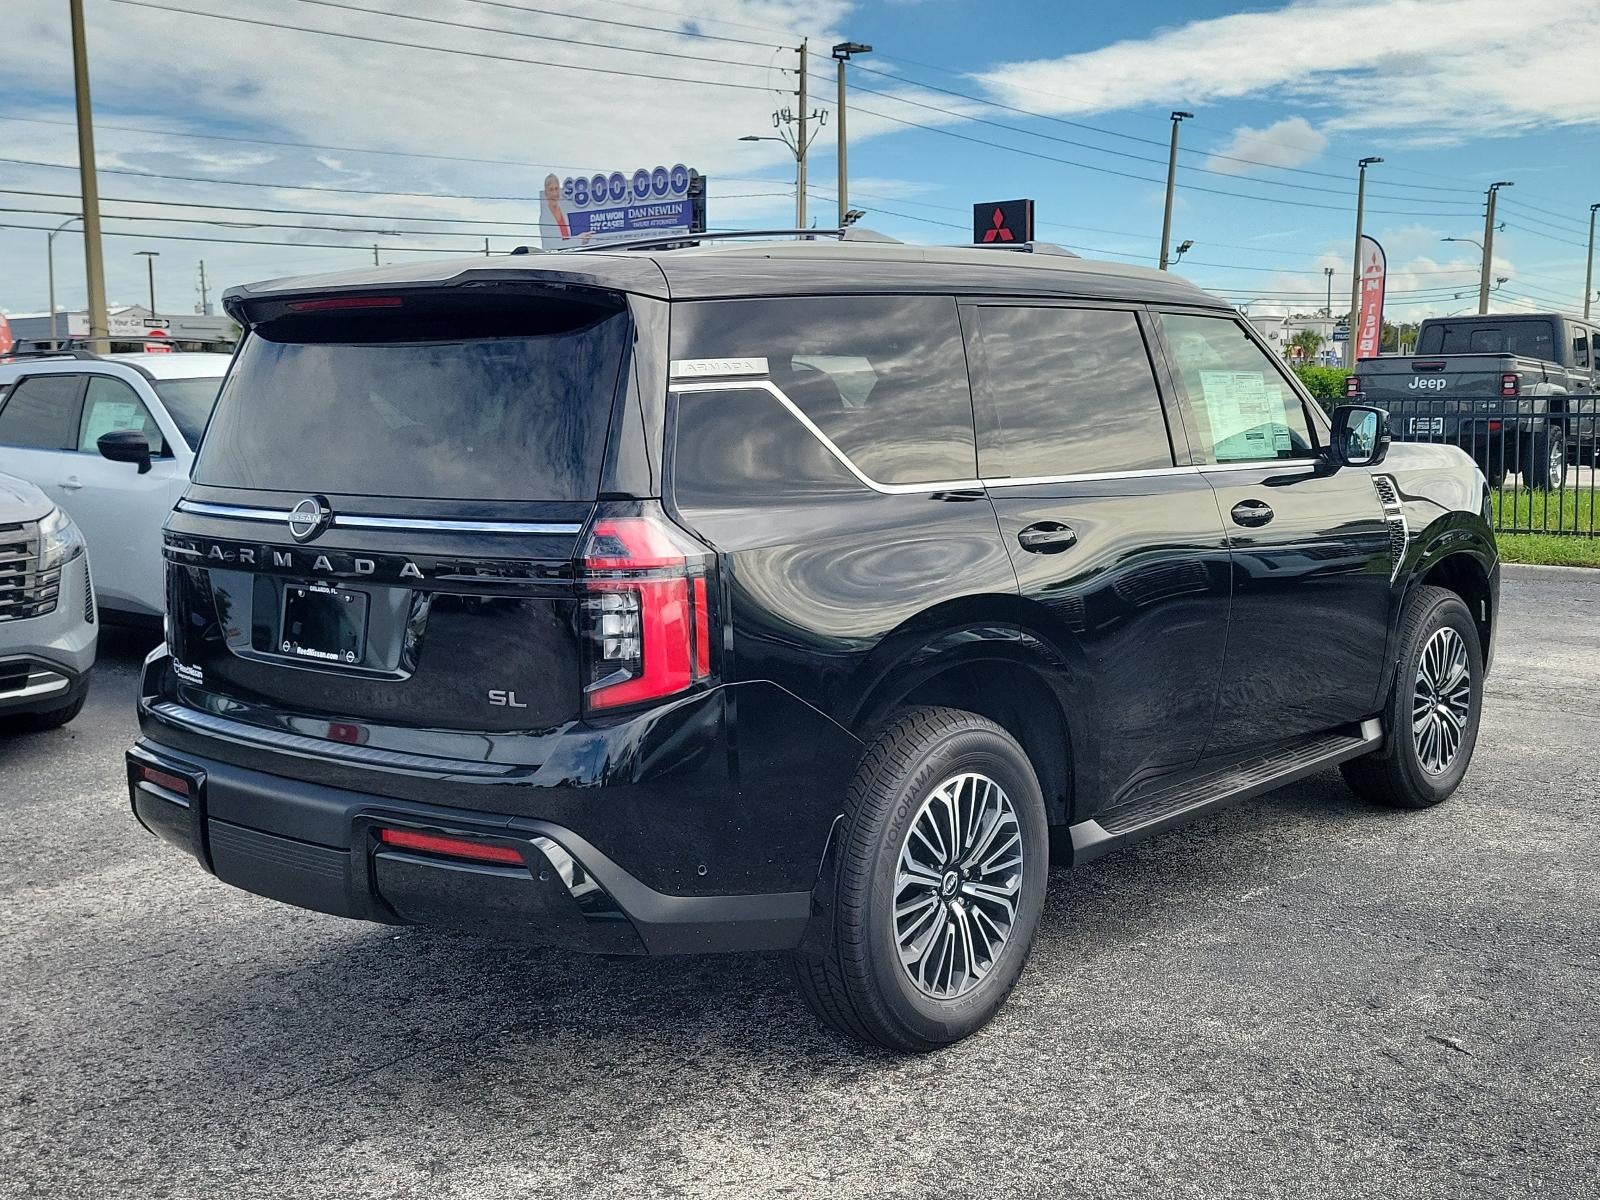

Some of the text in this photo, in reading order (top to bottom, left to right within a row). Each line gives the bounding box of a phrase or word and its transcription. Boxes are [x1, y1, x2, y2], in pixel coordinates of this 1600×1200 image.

[563, 164, 690, 208] $800,000
[590, 213, 606, 223] DAN
[628, 203, 683, 219] DAN NEWLIN
[687, 361, 753, 372] ARMADA
[1408, 377, 1447, 391] Jeep
[289, 513, 320, 523] ISSAN
[207, 545, 425, 579] ARMADA
[489, 690, 527, 708] SL
[883, 764, 935, 852] YOKOHAMA
